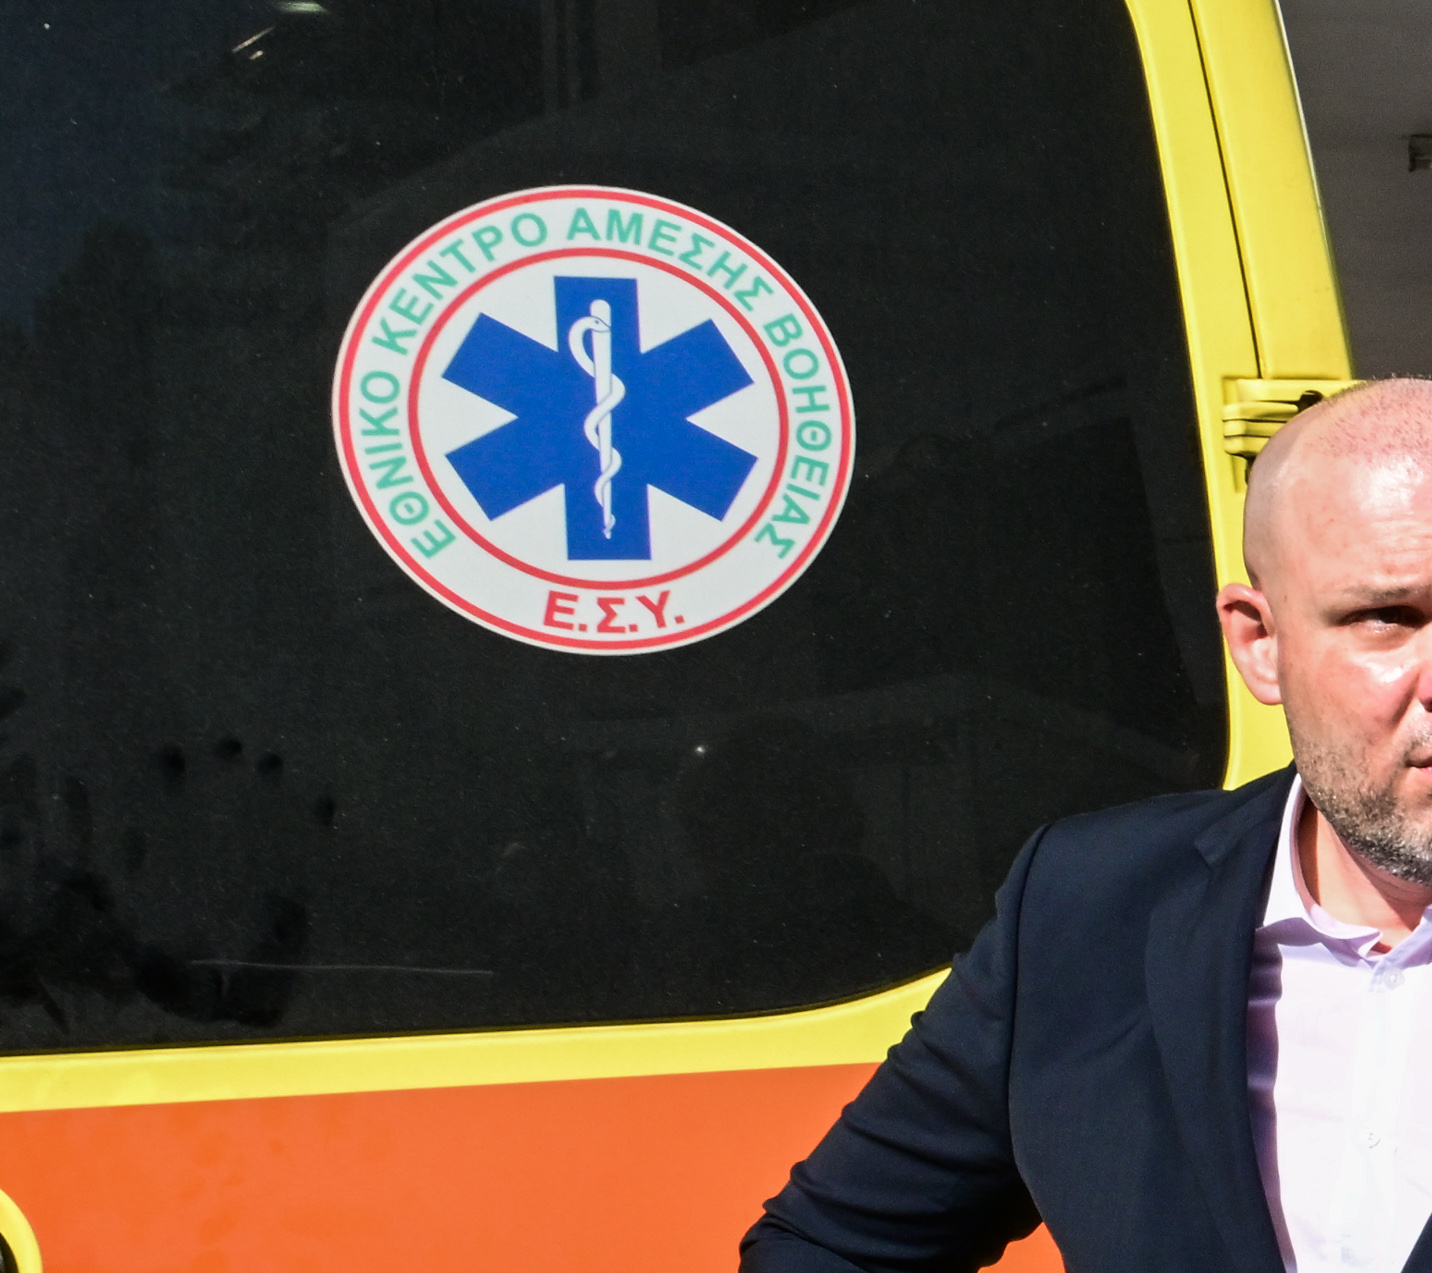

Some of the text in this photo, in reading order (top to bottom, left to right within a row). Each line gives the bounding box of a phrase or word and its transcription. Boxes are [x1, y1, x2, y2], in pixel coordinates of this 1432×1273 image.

[359, 206, 833, 560] ΕΘΝΙΚΟ ΚΕΝΤΡΟ ΑΜΕΣΗΣ ΒΟΗΘΕΙΑΣ
[542, 589, 686, 634] Ε.Σ.Υ.
